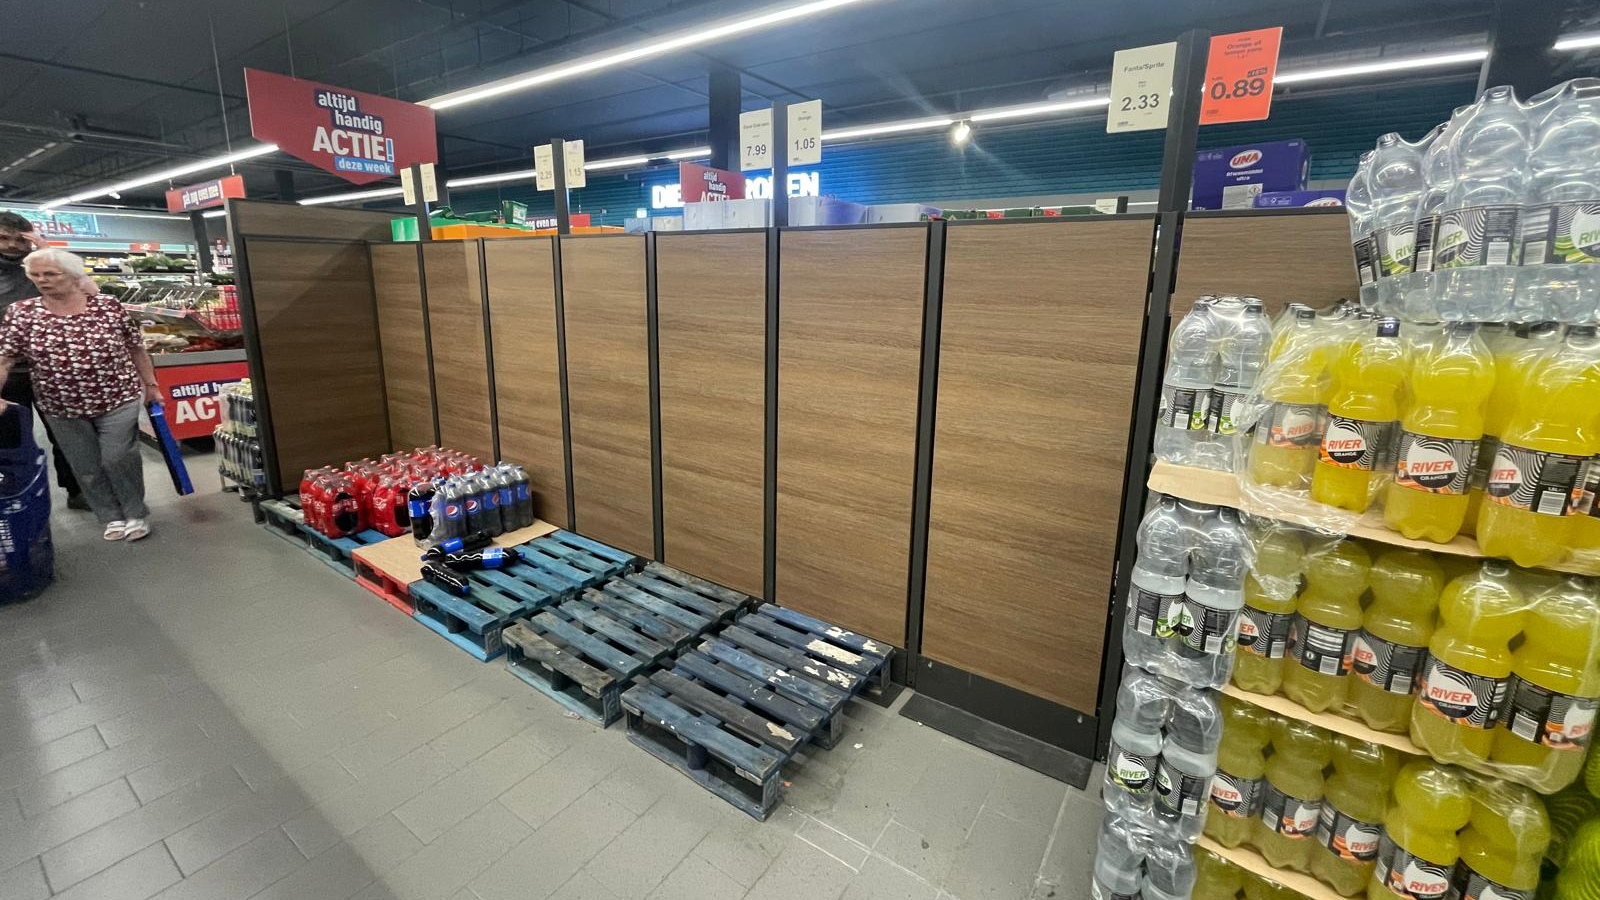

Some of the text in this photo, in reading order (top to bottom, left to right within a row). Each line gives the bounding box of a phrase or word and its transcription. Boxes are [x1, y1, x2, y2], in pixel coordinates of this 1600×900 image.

[1124, 62, 1164, 72] Fanta/Sprite
[1211, 78, 1265, 100] 0.89
[318, 91, 356, 112] altijd
[1121, 93, 1160, 111] 2.33
[335, 110, 382, 134] handig
[313, 126, 395, 163] ACTIE!
[747, 144, 767, 156] 7.99
[795, 138, 815, 150] 1.05
[339, 158, 392, 174] deze week
[1232, 152, 1260, 167] UNA
[703, 171, 717, 181] altijd
[708, 181, 727, 193] handig
[172, 383, 209, 398] altijd
[1328, 439, 1361, 450] RIVER
[1411, 461, 1454, 473] RIVER
[1431, 686, 1472, 703] RIVER
[1119, 769, 1148, 780] RIVER
